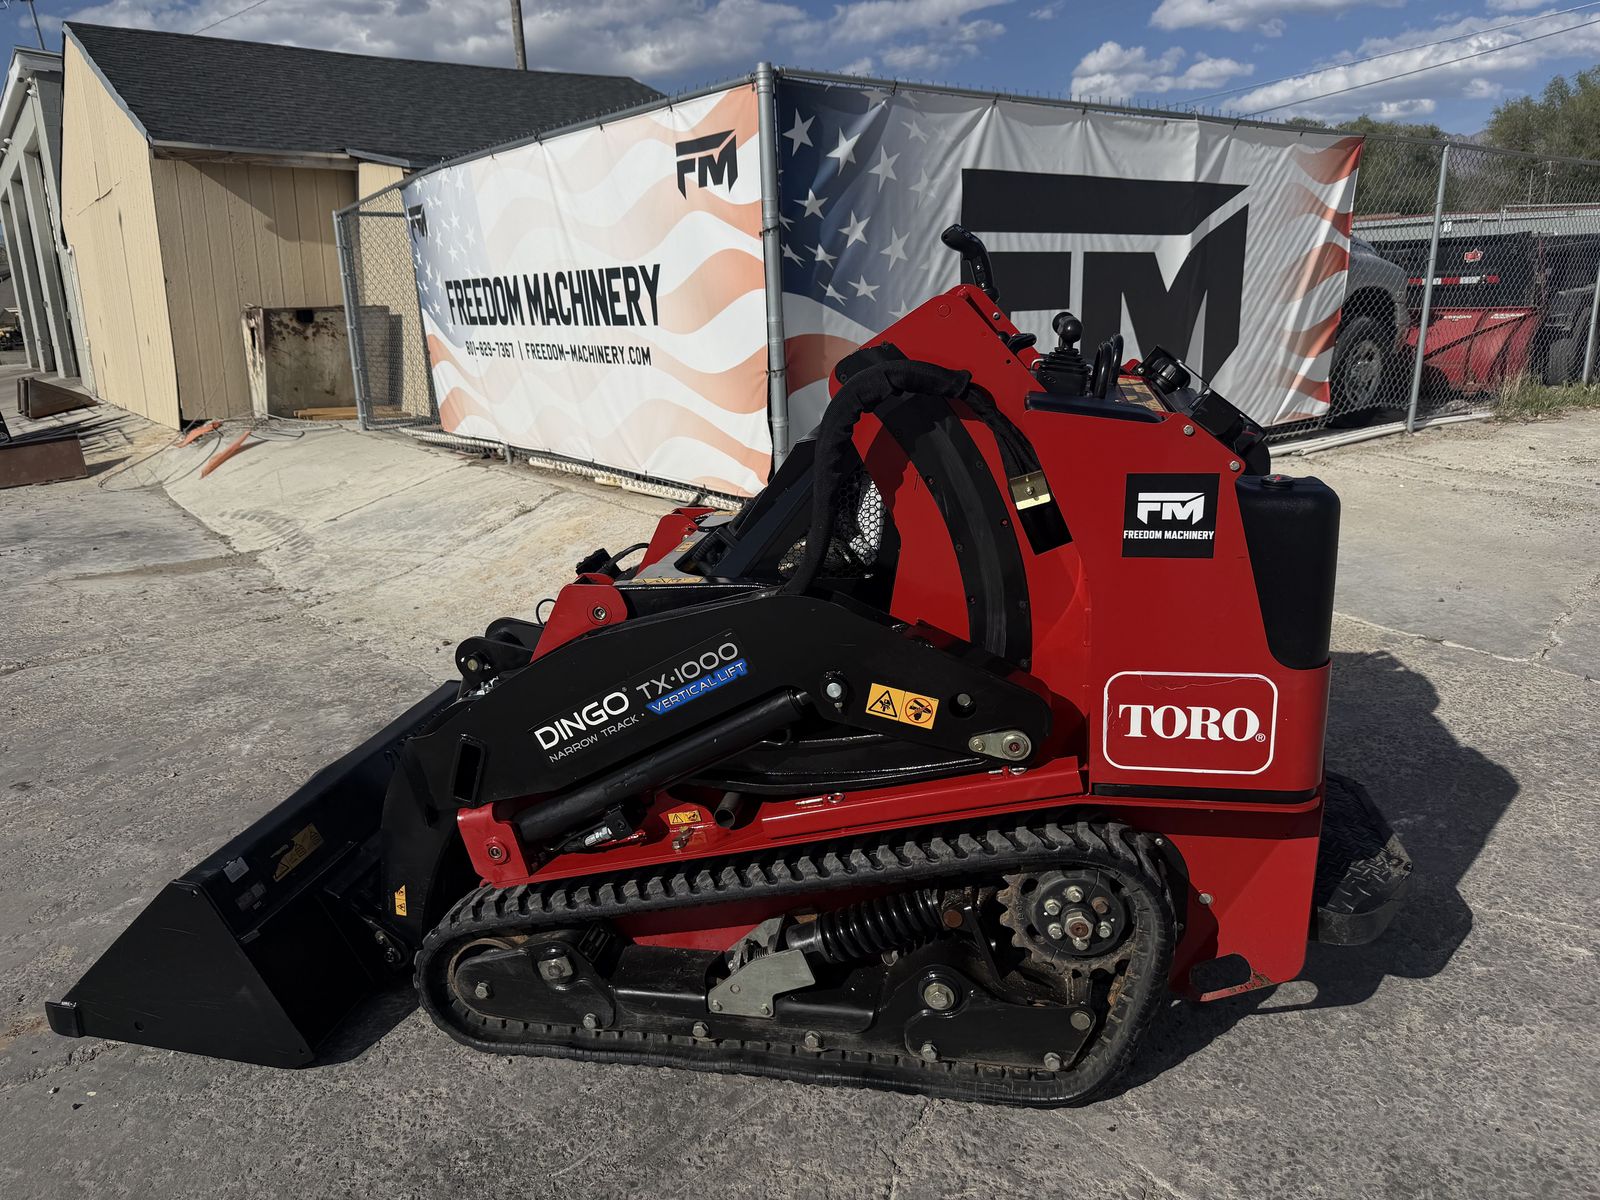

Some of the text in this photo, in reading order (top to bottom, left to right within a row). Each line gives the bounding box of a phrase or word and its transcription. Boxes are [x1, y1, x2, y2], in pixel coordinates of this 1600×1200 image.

[675, 128, 738, 200] FM
[445, 264, 660, 326] FREEDOM MACHINERY
[465, 341, 515, 359] 801-829-7367
[524, 342, 652, 366] FREEDOM-MACHINERY.COM
[1136, 492, 1205, 525] FM
[1123, 530, 1215, 540] FREEDOM MACHINERY
[548, 661, 745, 763] NARROW TRACK VERTICAL LIFT
